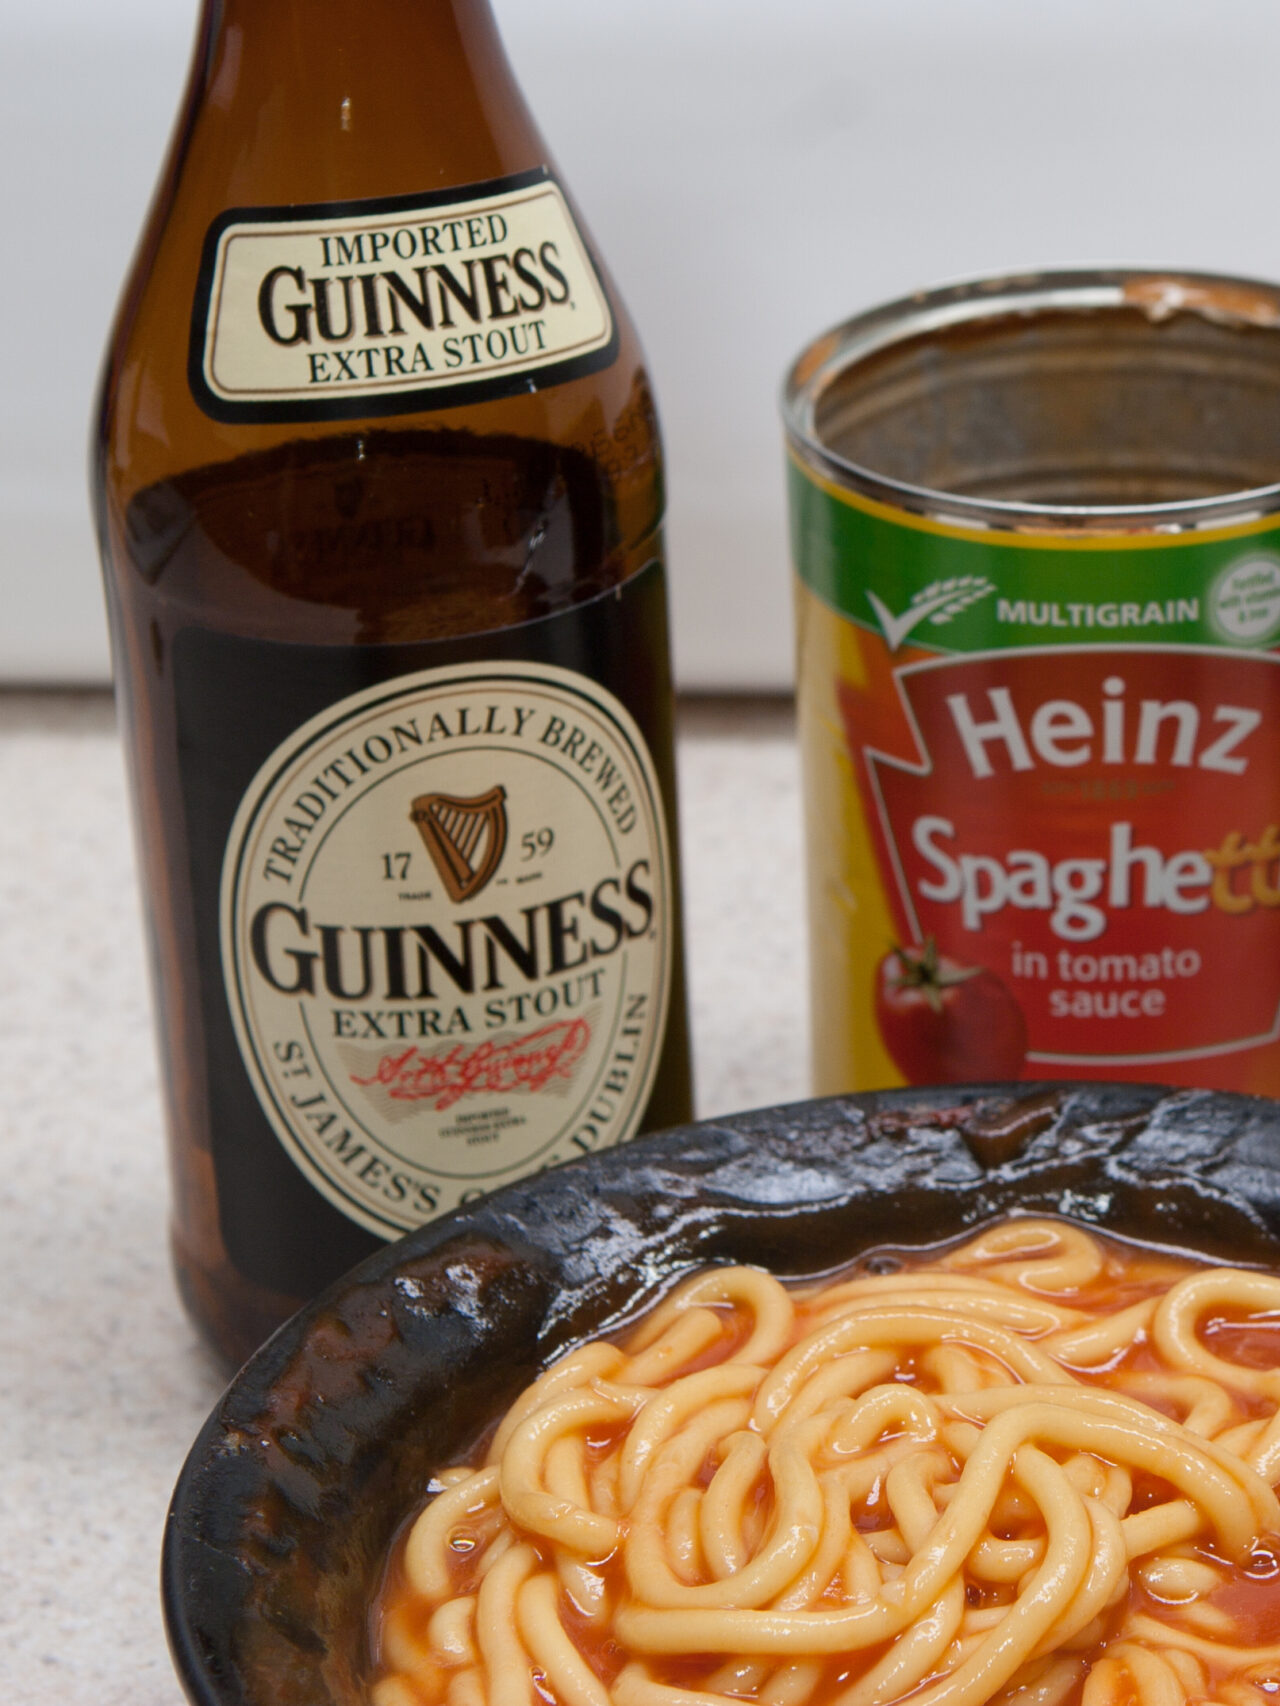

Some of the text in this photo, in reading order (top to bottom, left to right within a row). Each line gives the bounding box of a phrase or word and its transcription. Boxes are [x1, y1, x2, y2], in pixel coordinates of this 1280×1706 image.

[320, 214, 509, 268] IMPORTED
[258, 241, 571, 347] GUINNESS
[308, 320, 547, 384] EXTRA STOUT
[997, 599, 1199, 628] MULTIGRAIN
[946, 676, 1262, 779] Heinz
[263, 705, 637, 886] TRADITIONALLY BREWED
[381, 852, 412, 880] 17
[521, 826, 555, 861] 59
[250, 859, 656, 1001] GUINNESS
[1012, 941, 1201, 982] in tomato
[332, 968, 607, 1039] EXTRA STOUT
[1049, 988, 1166, 1018] sauce
[571, 993, 649, 1155] DUBLIN
[290, 1092, 441, 1215] JAMES'S
